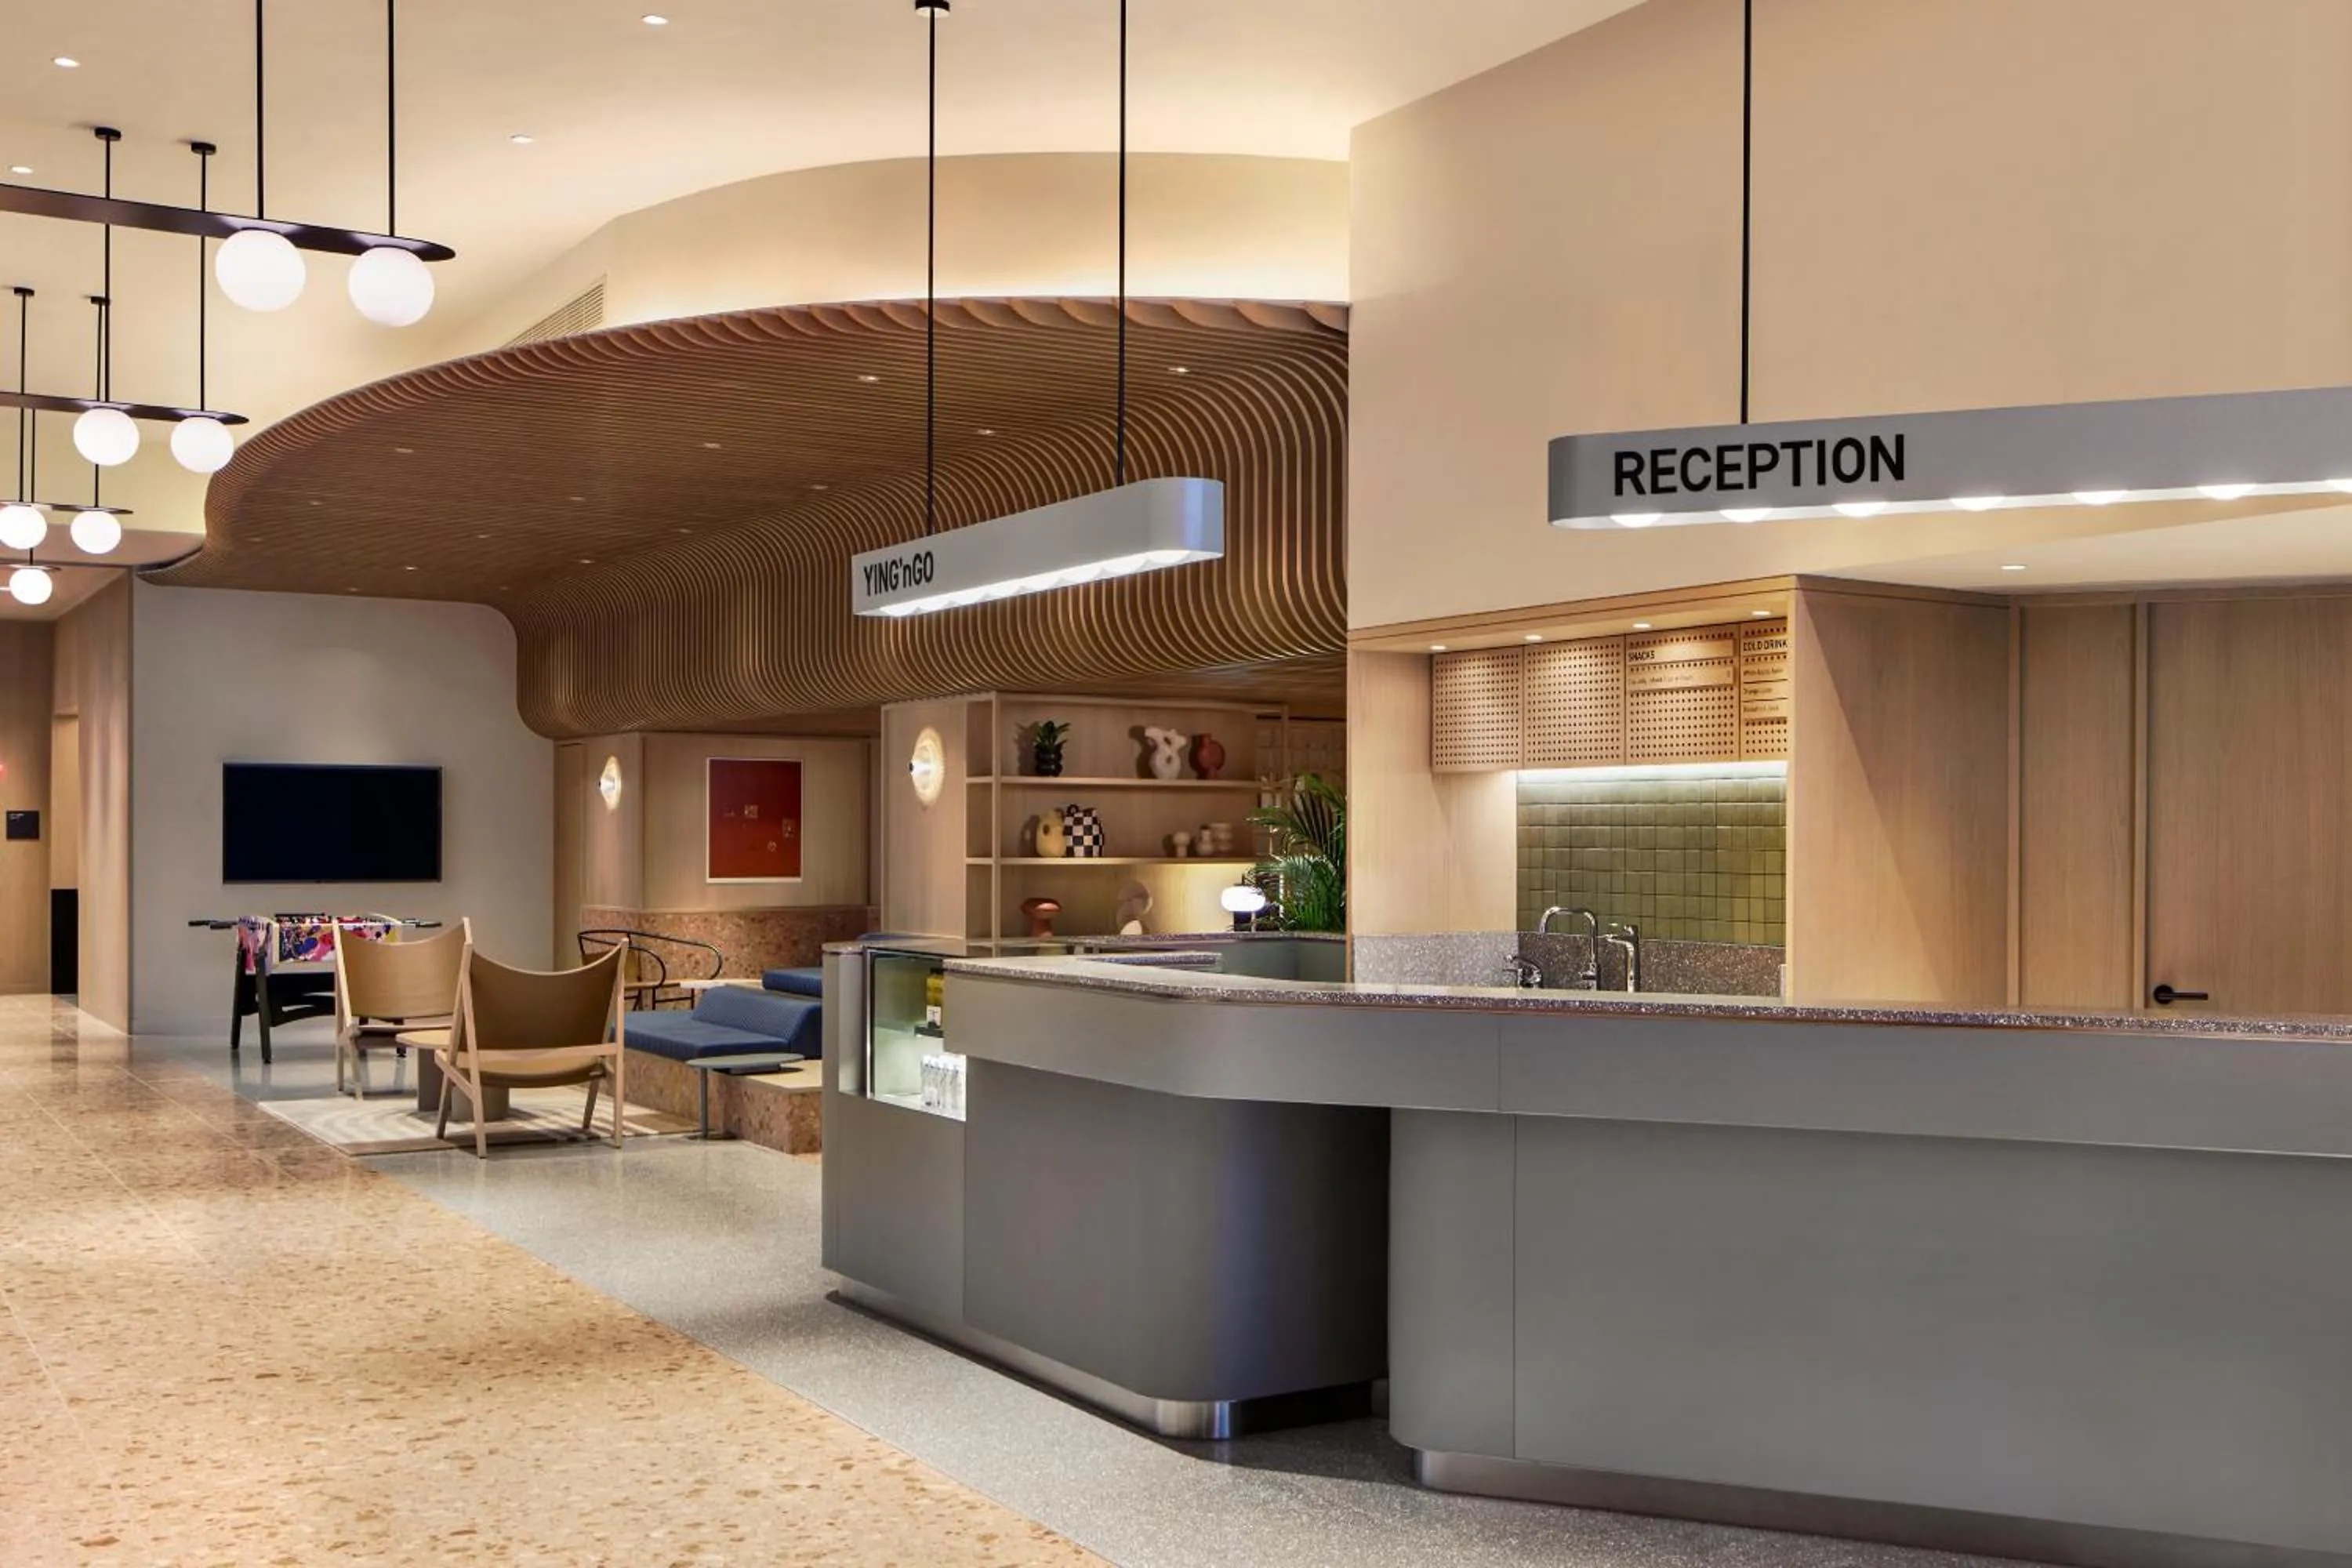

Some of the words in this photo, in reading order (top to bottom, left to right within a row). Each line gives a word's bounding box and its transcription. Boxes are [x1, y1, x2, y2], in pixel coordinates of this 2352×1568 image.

[1614, 434, 1905, 496] RECEPTION
[863, 550, 934, 597] YING'nGO
[1628, 650, 1655, 662] SNACKS
